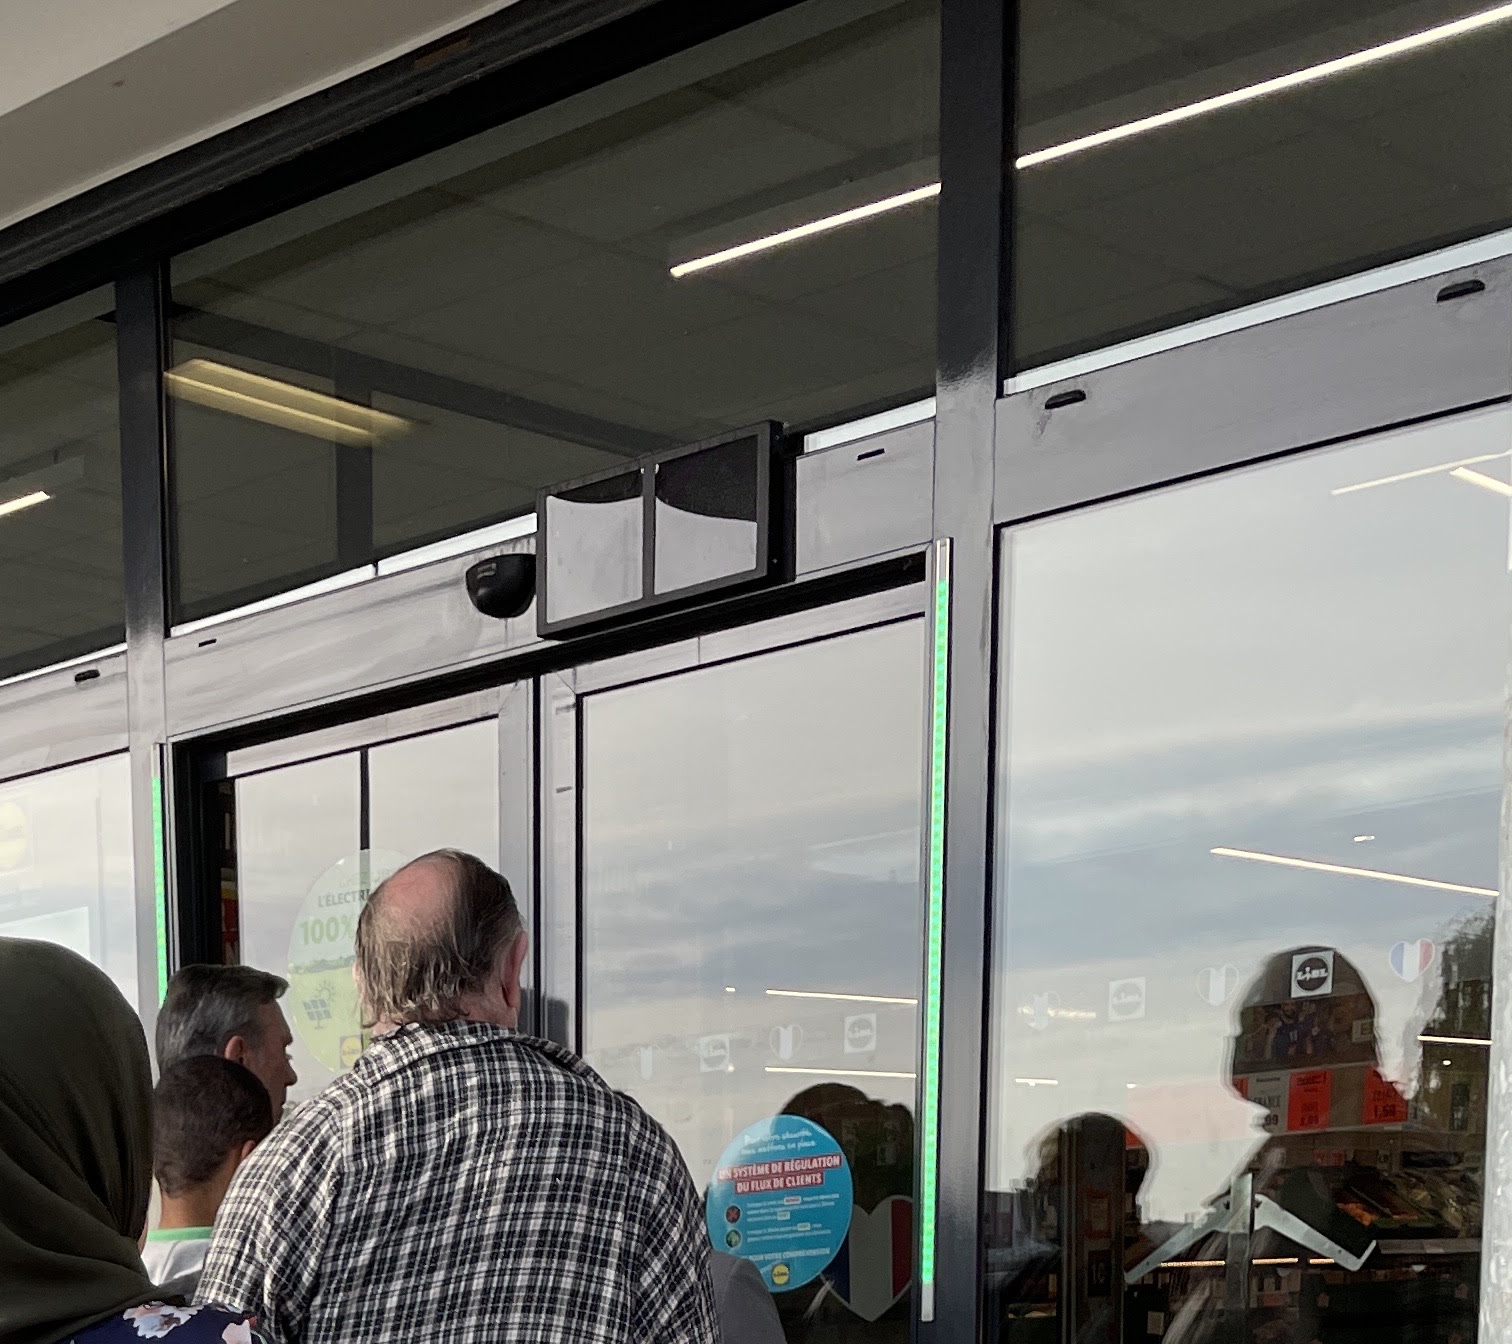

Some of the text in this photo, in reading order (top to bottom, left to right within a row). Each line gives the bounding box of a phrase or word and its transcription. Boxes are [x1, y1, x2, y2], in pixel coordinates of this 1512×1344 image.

[317, 889, 370, 908] L'ÉLECTRI
[733, 1163, 770, 1179] SYSTÈME
[771, 1162, 783, 1174] DE
[784, 1155, 841, 1172] RÉGULATION
[736, 1173, 822, 1194] DU FLUX DE CLIENTS
